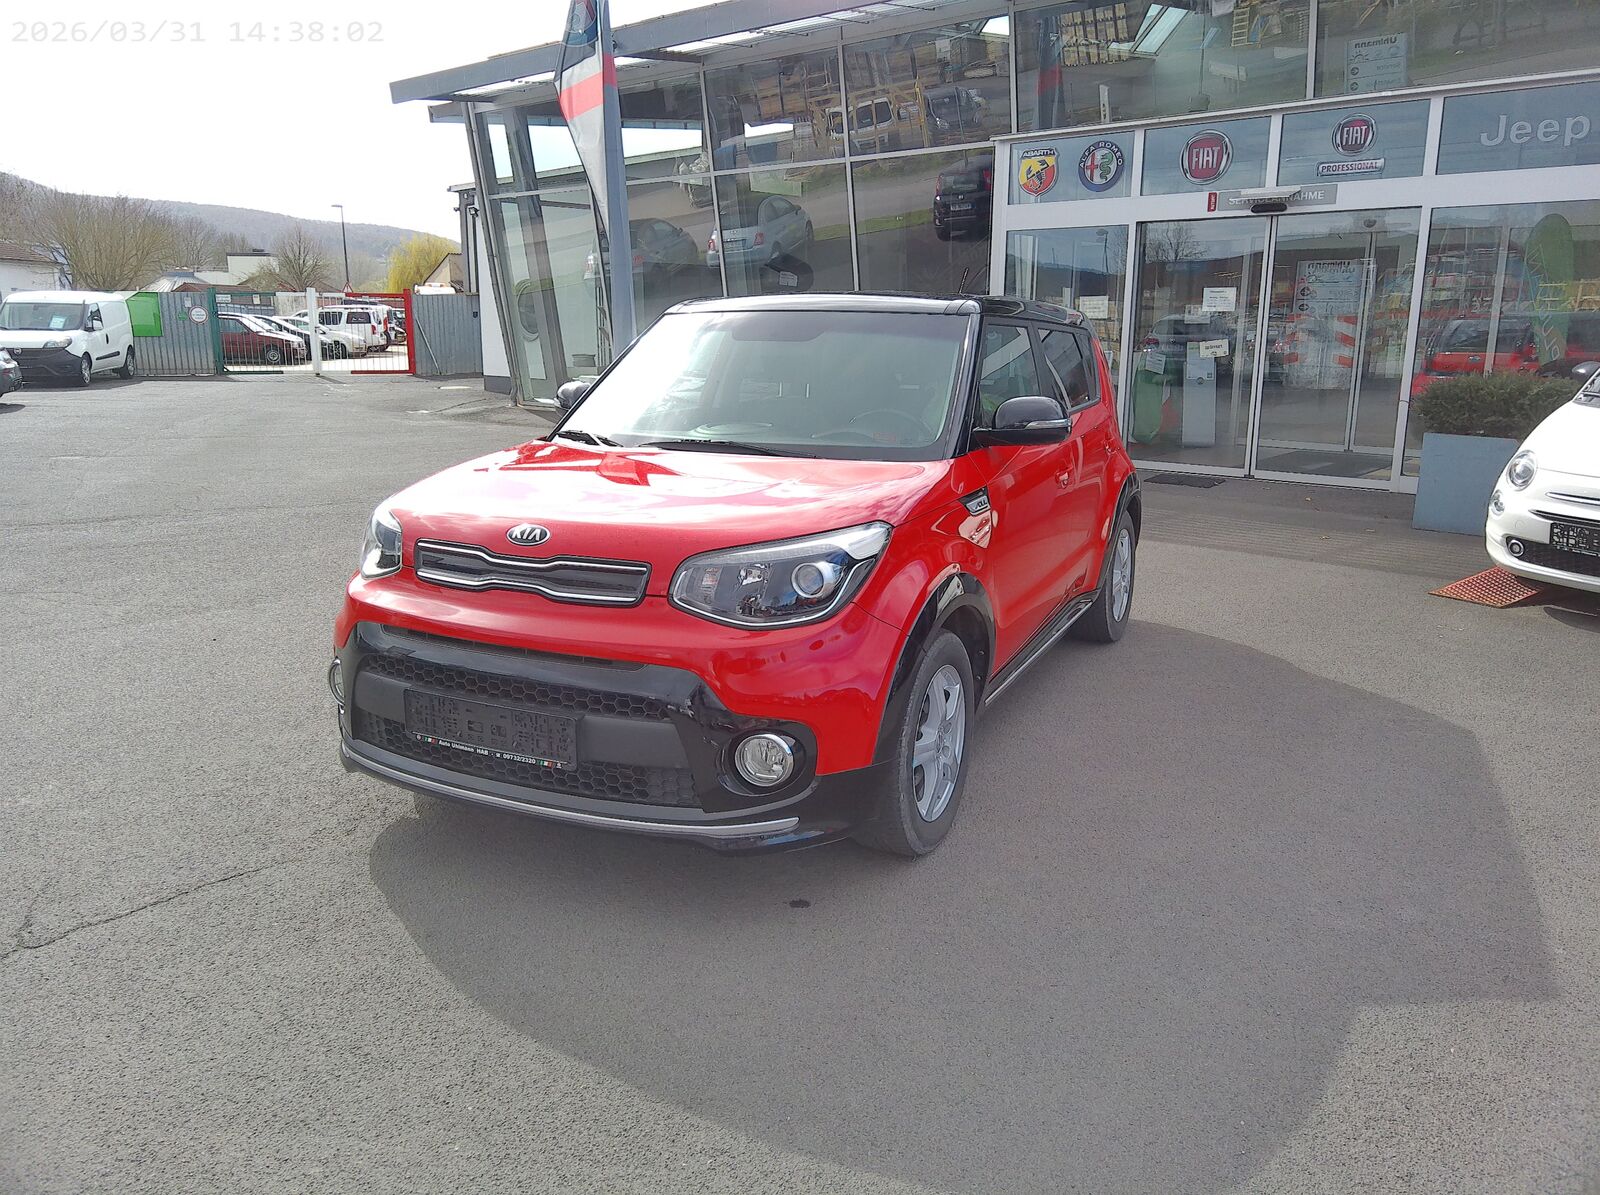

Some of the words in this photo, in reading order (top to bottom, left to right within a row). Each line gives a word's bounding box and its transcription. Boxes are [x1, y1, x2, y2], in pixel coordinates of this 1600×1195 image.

[1342, 124, 1369, 146] FIAT
[1480, 114, 1592, 147] Jeep
[1022, 149, 1054, 157] ABARTH
[1079, 145, 1095, 168] ALFA
[1098, 141, 1124, 166] ROMEO
[1191, 145, 1221, 170] FIAT
[1320, 161, 1379, 174] PROFESSIONAL
[512, 527, 541, 541] KIA
[438, 739, 451, 748] Auto
[451, 742, 475, 752] Uhlmann
[476, 748, 489, 756] HAB
[503, 753, 536, 764] 09732/2320
